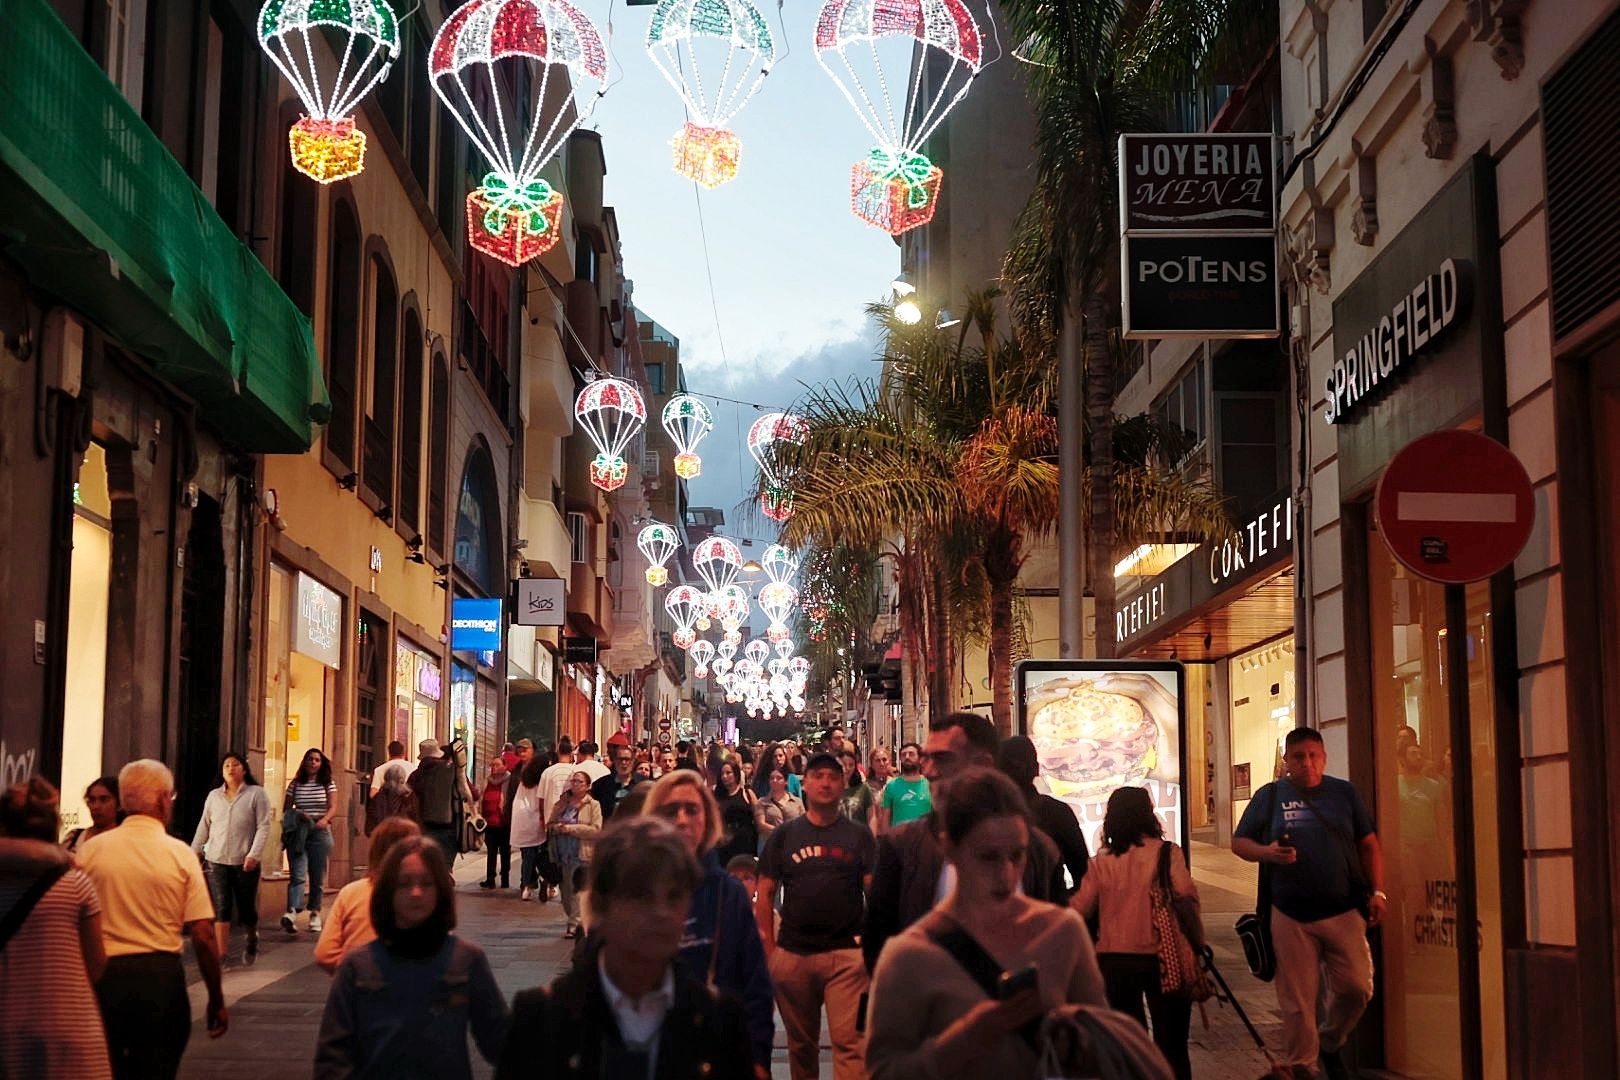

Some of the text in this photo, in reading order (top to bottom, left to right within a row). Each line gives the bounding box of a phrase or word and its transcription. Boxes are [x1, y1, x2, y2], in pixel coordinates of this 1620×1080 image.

[1135, 144, 1262, 176] JOYERIA
[1131, 176, 1264, 205] MENA
[1139, 255, 1268, 283] POTENS
[1324, 257, 1457, 425] SPRINGFIELD
[1210, 497, 1292, 584] CORTEFI
[1116, 582, 1166, 642] RTEFIEL
[1425, 880, 1456, 911] MERR
[1414, 914, 1483, 951] CHRISTS
